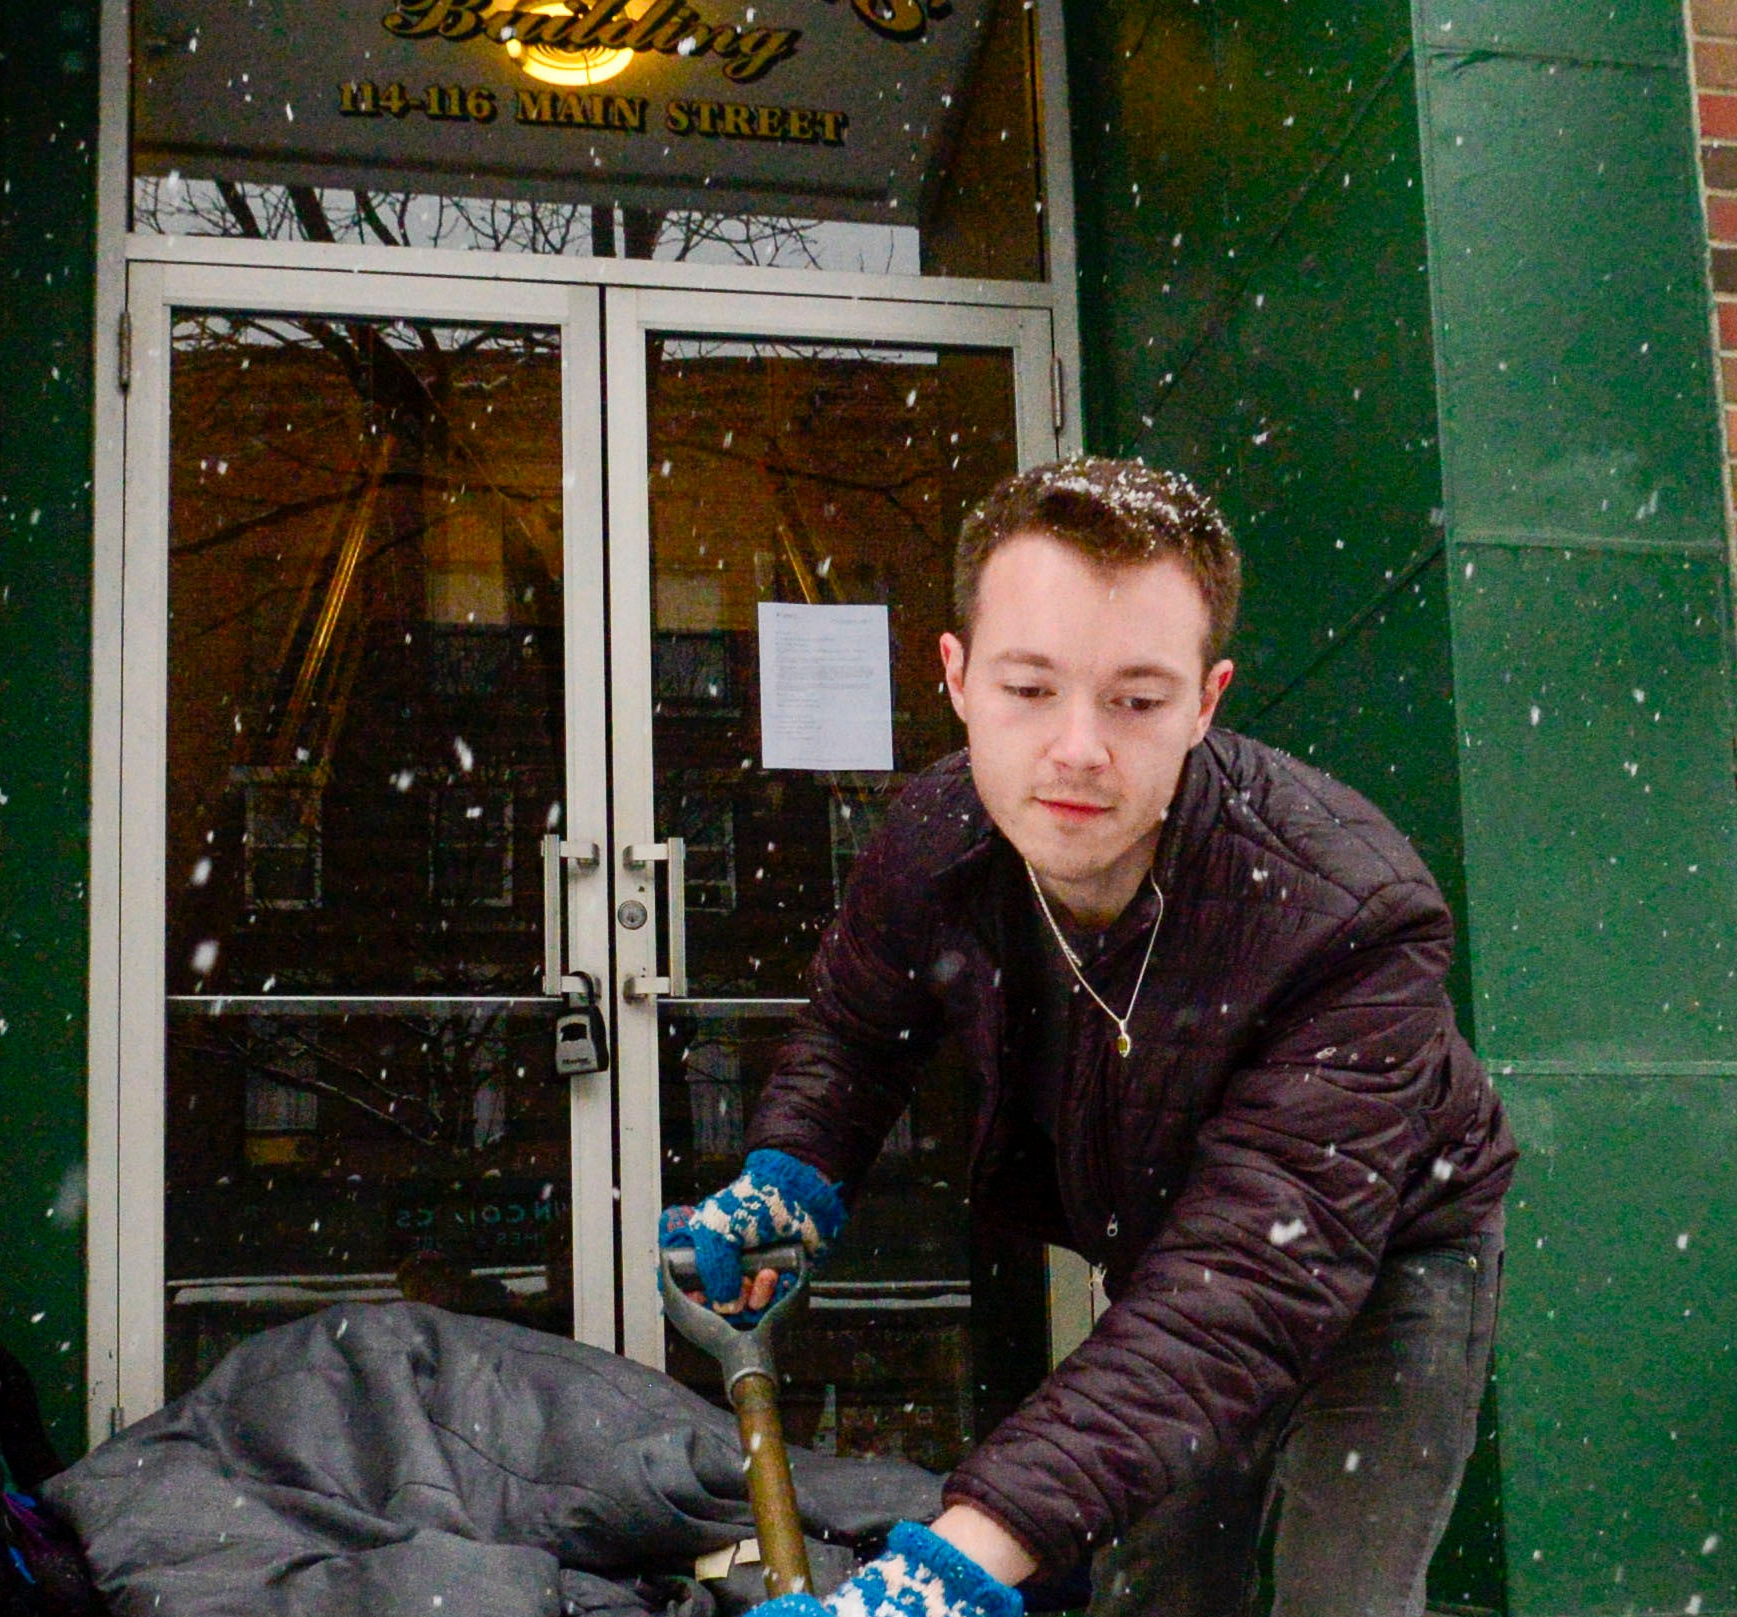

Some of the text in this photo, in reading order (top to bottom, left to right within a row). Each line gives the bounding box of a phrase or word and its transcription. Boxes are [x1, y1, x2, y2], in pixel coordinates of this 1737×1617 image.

[338, 81, 850, 147] 114-116 MAIN STREET
